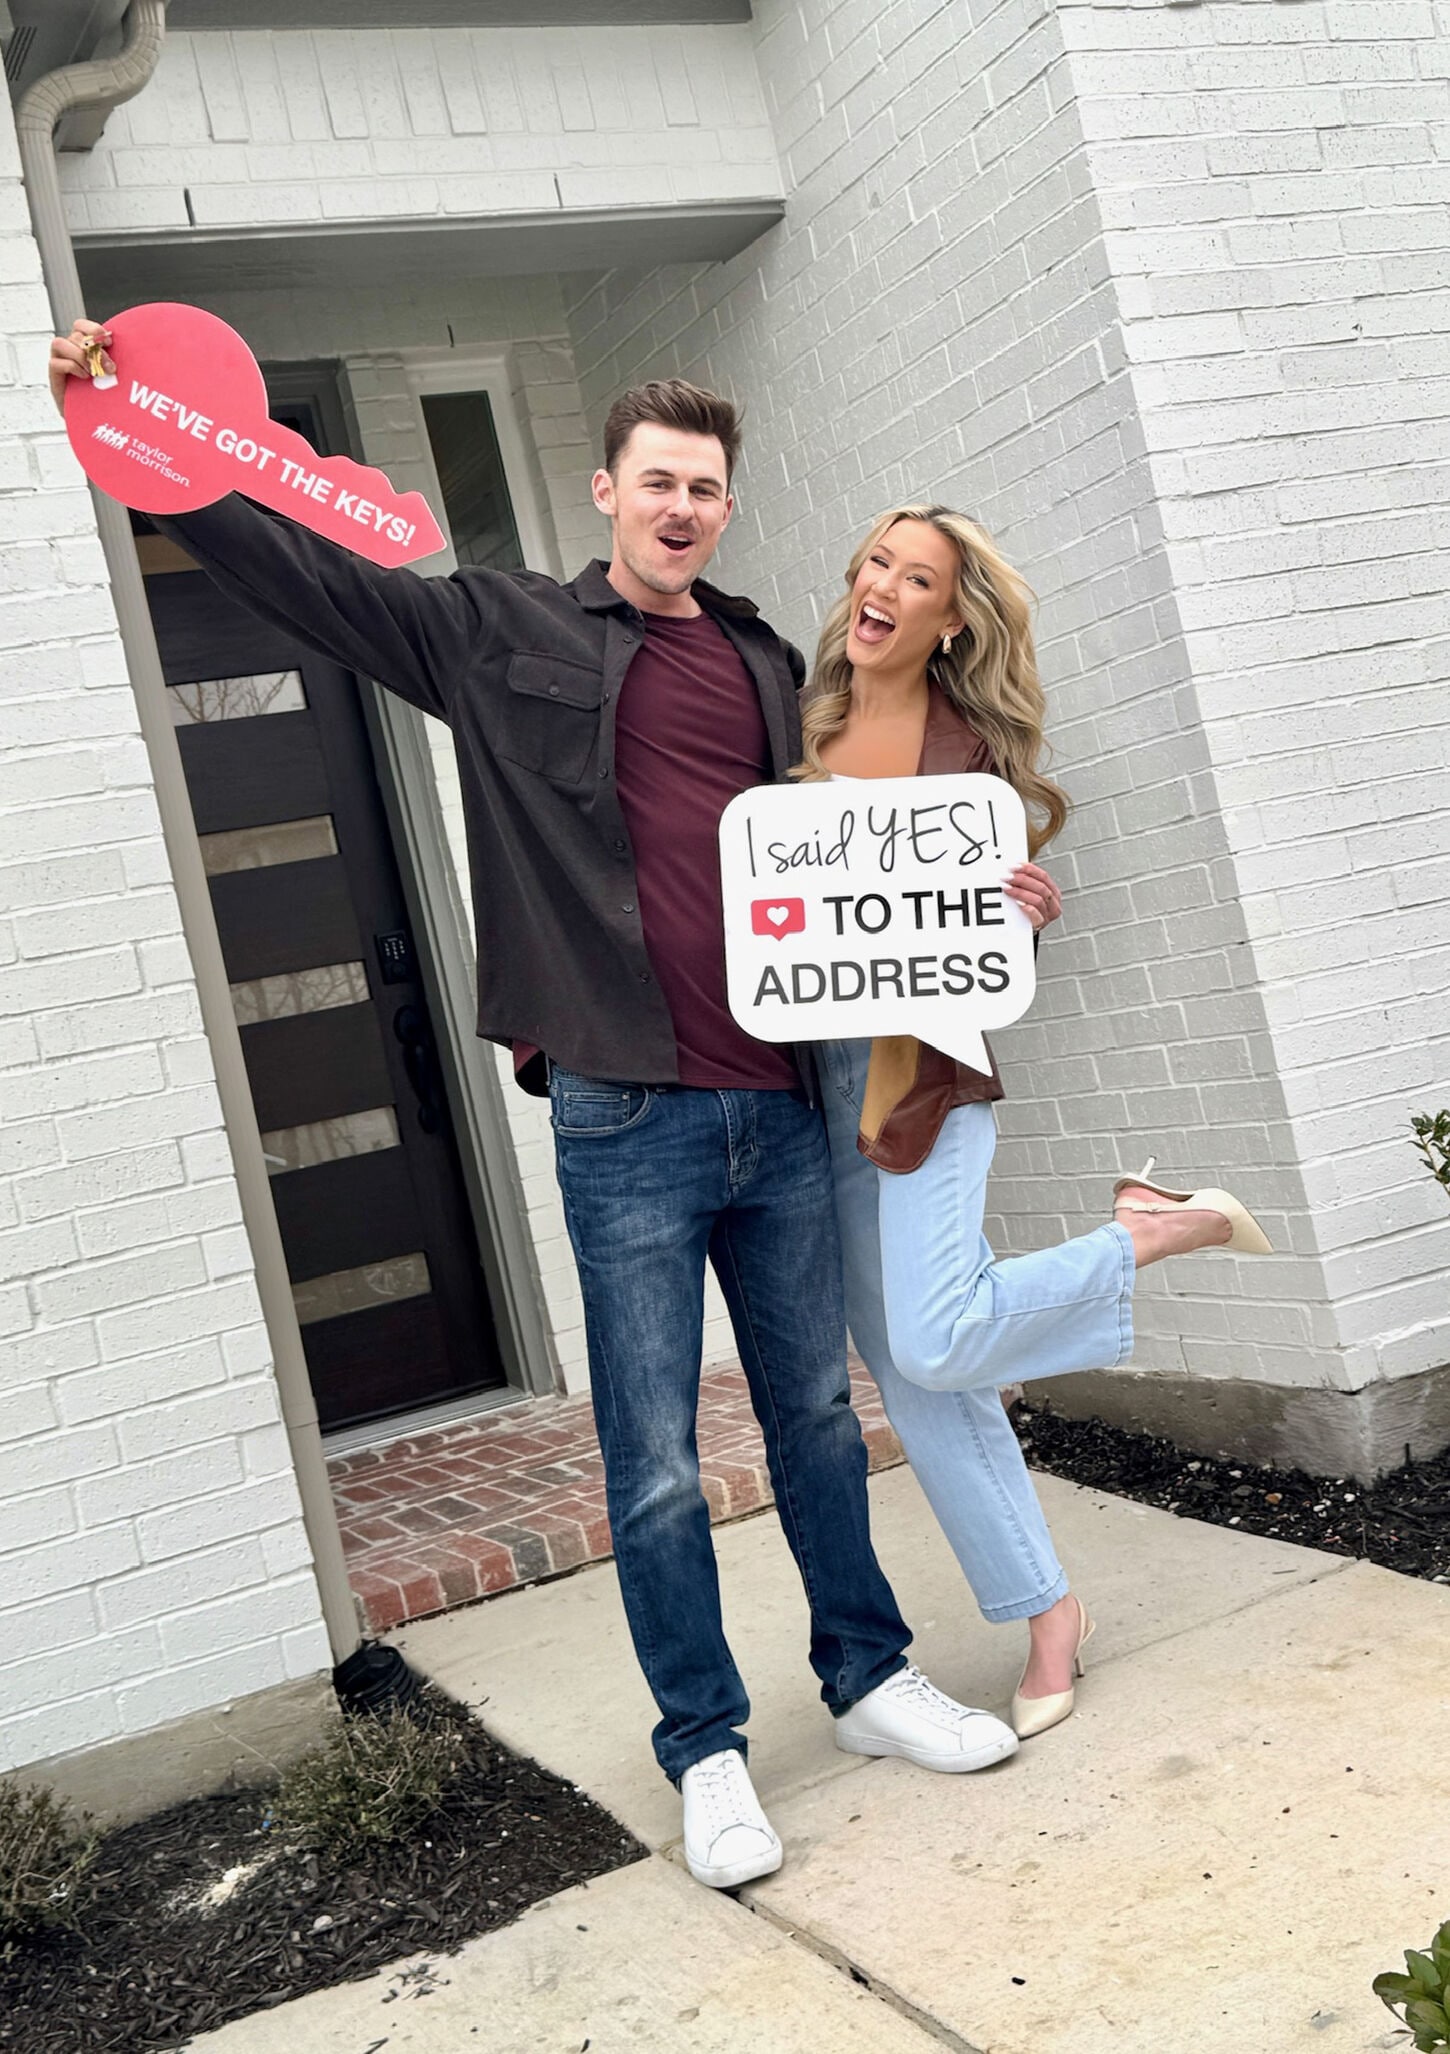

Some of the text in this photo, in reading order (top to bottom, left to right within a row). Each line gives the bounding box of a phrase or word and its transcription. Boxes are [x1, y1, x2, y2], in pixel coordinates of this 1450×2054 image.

[125, 448, 191, 487] morrison
[129, 380, 416, 547] WE'VE GOT THE KEYS!
[131, 438, 174, 464] taylor
[746, 800, 1002, 877] I said YES!
[822, 886, 1005, 936] TO THE
[752, 951, 1011, 1007] ADDRESS
